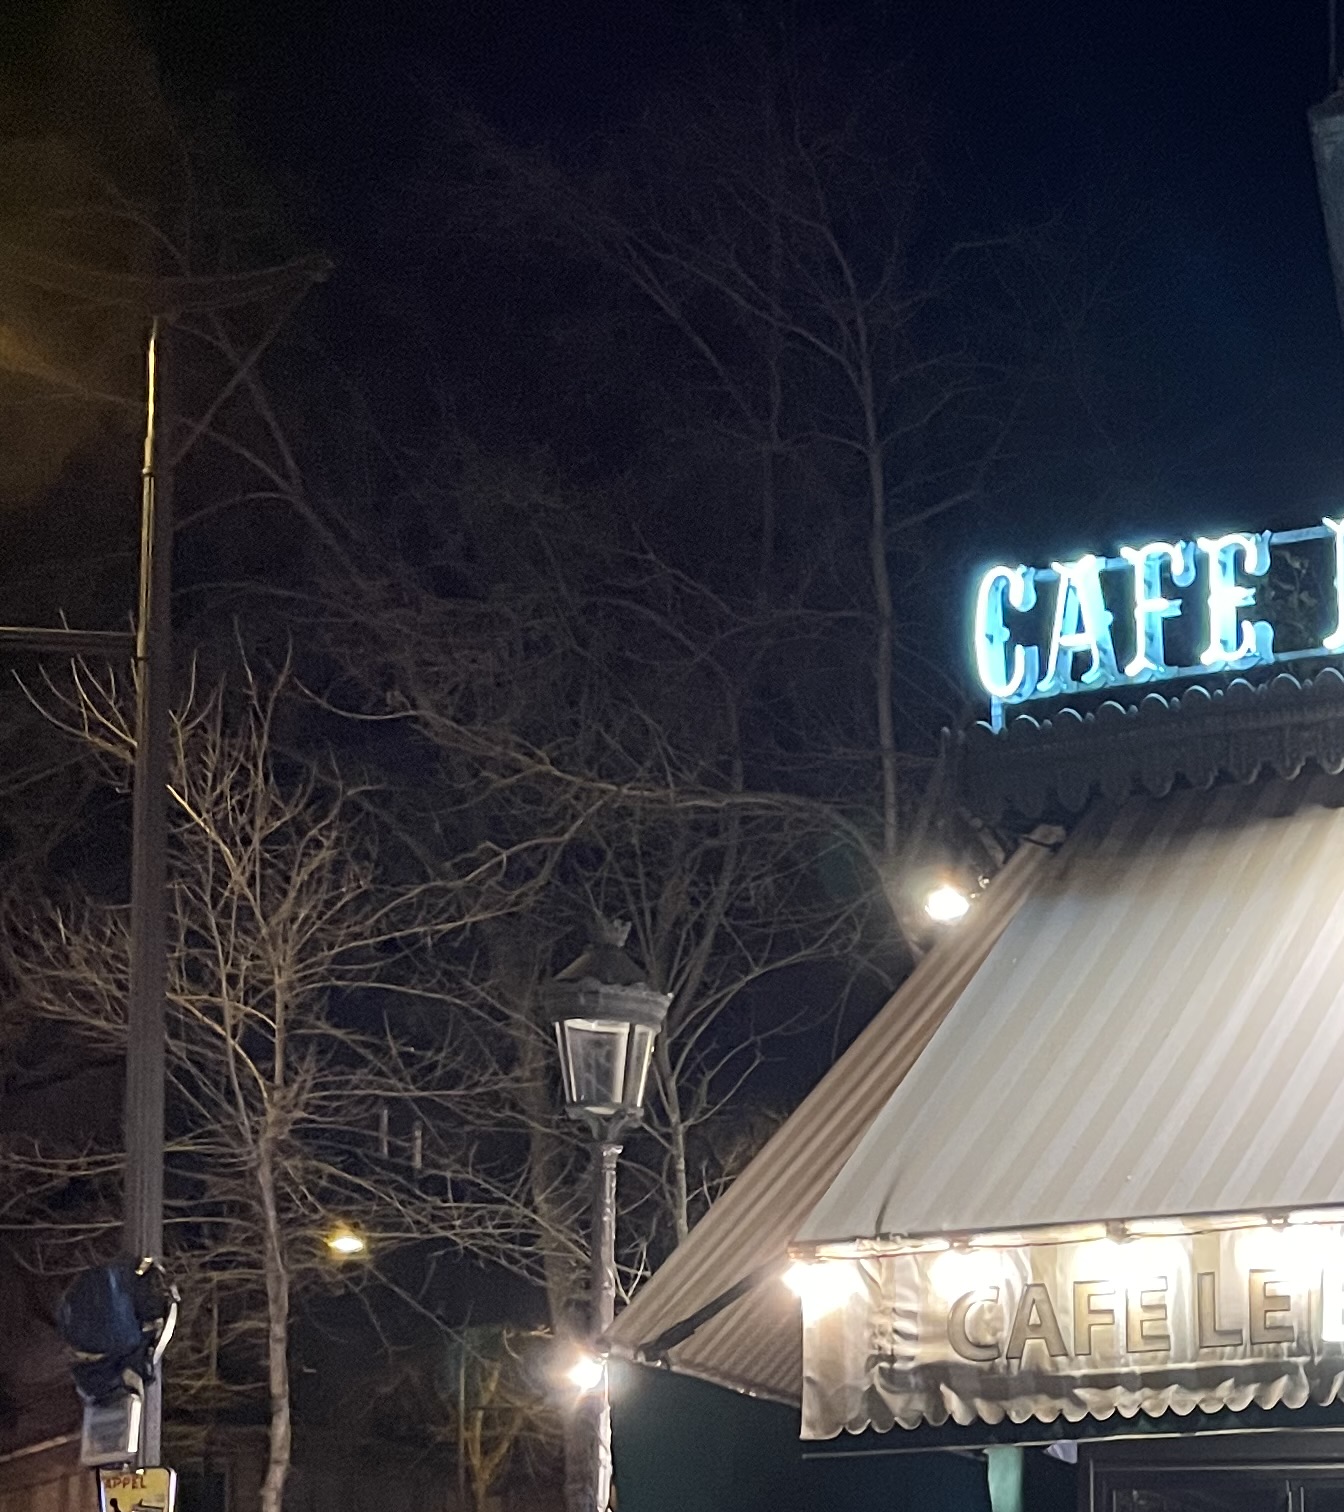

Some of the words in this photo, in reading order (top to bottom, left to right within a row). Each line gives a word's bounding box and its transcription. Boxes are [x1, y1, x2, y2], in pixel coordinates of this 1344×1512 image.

[975, 529, 1274, 701] CAFE
[947, 1275, 1171, 1362] CAFE
[1197, 1268, 1295, 1349] LE
